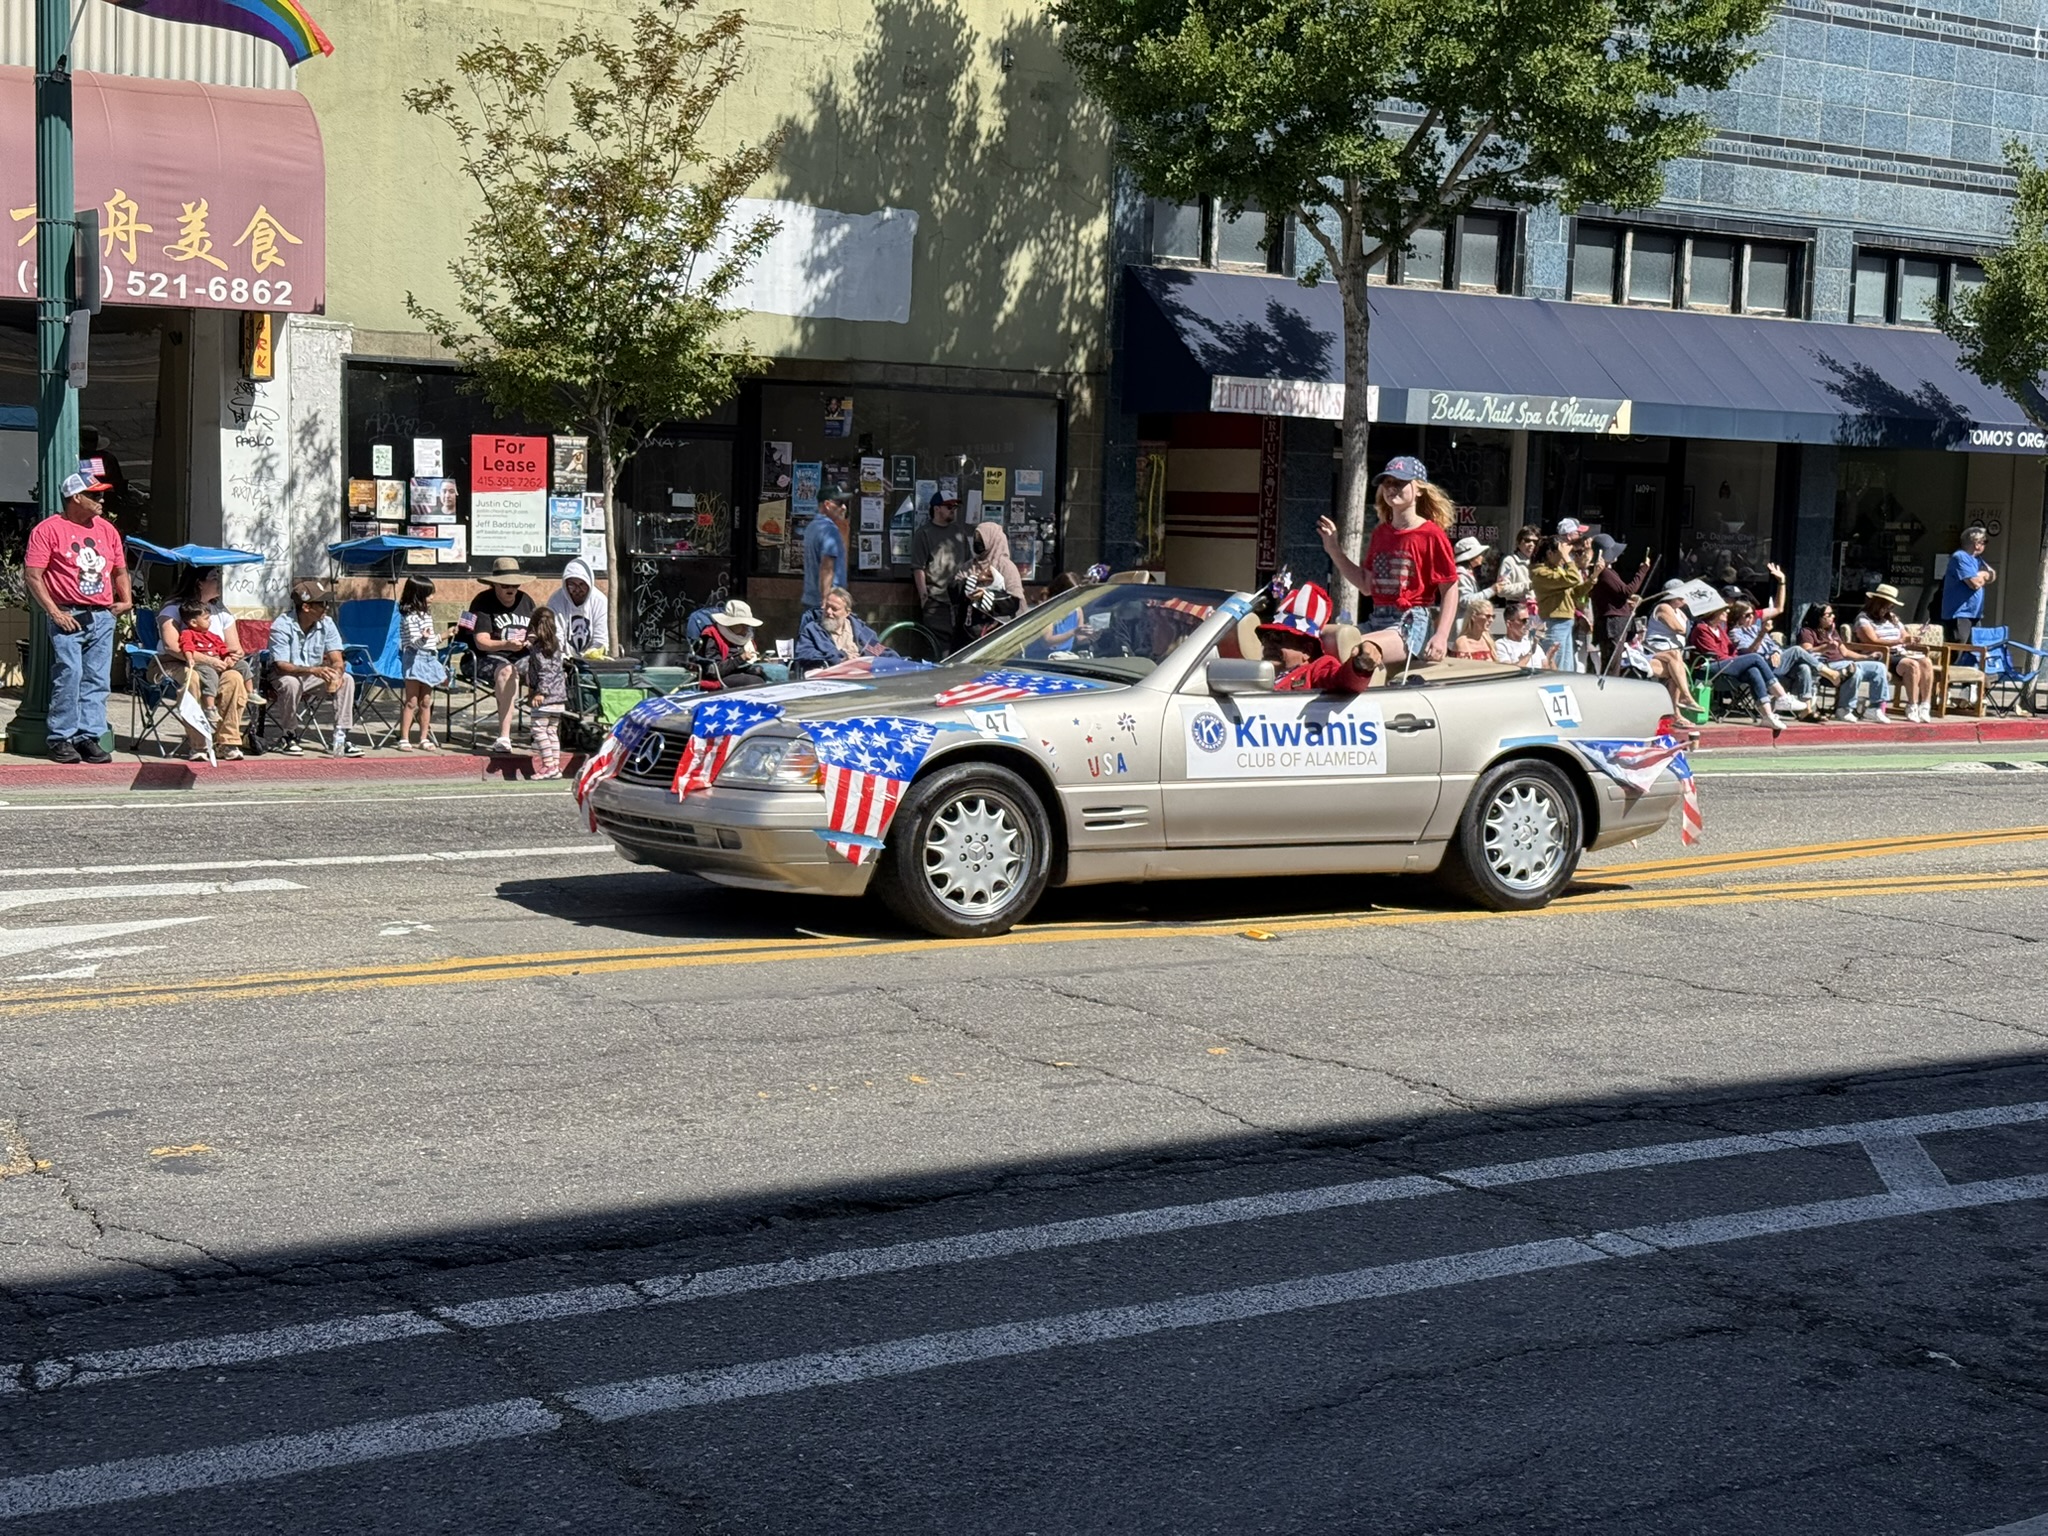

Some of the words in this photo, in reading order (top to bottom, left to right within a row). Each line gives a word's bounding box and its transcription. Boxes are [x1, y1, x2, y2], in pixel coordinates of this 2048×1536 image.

[126, 271, 293, 306] 521-6862
[1219, 383, 1269, 412] LITTLE
[1431, 393, 1476, 421] Bella
[1476, 396, 1513, 424] Nail
[1515, 400, 1543, 430] Spa
[1545, 400, 1559, 426] &
[1560, 399, 1610, 433] Waxing
[235, 435, 275, 448] PABLO
[495, 438, 526, 455] For
[1968, 429, 2014, 447] TOMO'S
[483, 455, 536, 473] Lease
[477, 476, 543, 488] 415.395.7262
[986, 470, 1003, 478] IMP
[475, 500, 501, 508] Justin
[502, 500, 522, 508] Choi
[475, 520, 491, 528] Jeff
[492, 520, 536, 529] Badstubner
[1261, 498, 1277, 560] TELLER
[494, 613, 512, 629] OLD
[1552, 695, 1570, 717] 47
[986, 712, 1010, 733] 47
[1201, 720, 1217, 741] K
[1234, 713, 1378, 748] Kiwanis
[1087, 752, 1128, 778] USA
[1236, 753, 1276, 768] CLUB
[1280, 752, 1301, 767] OF
[1304, 751, 1378, 767] ALAMEDA
